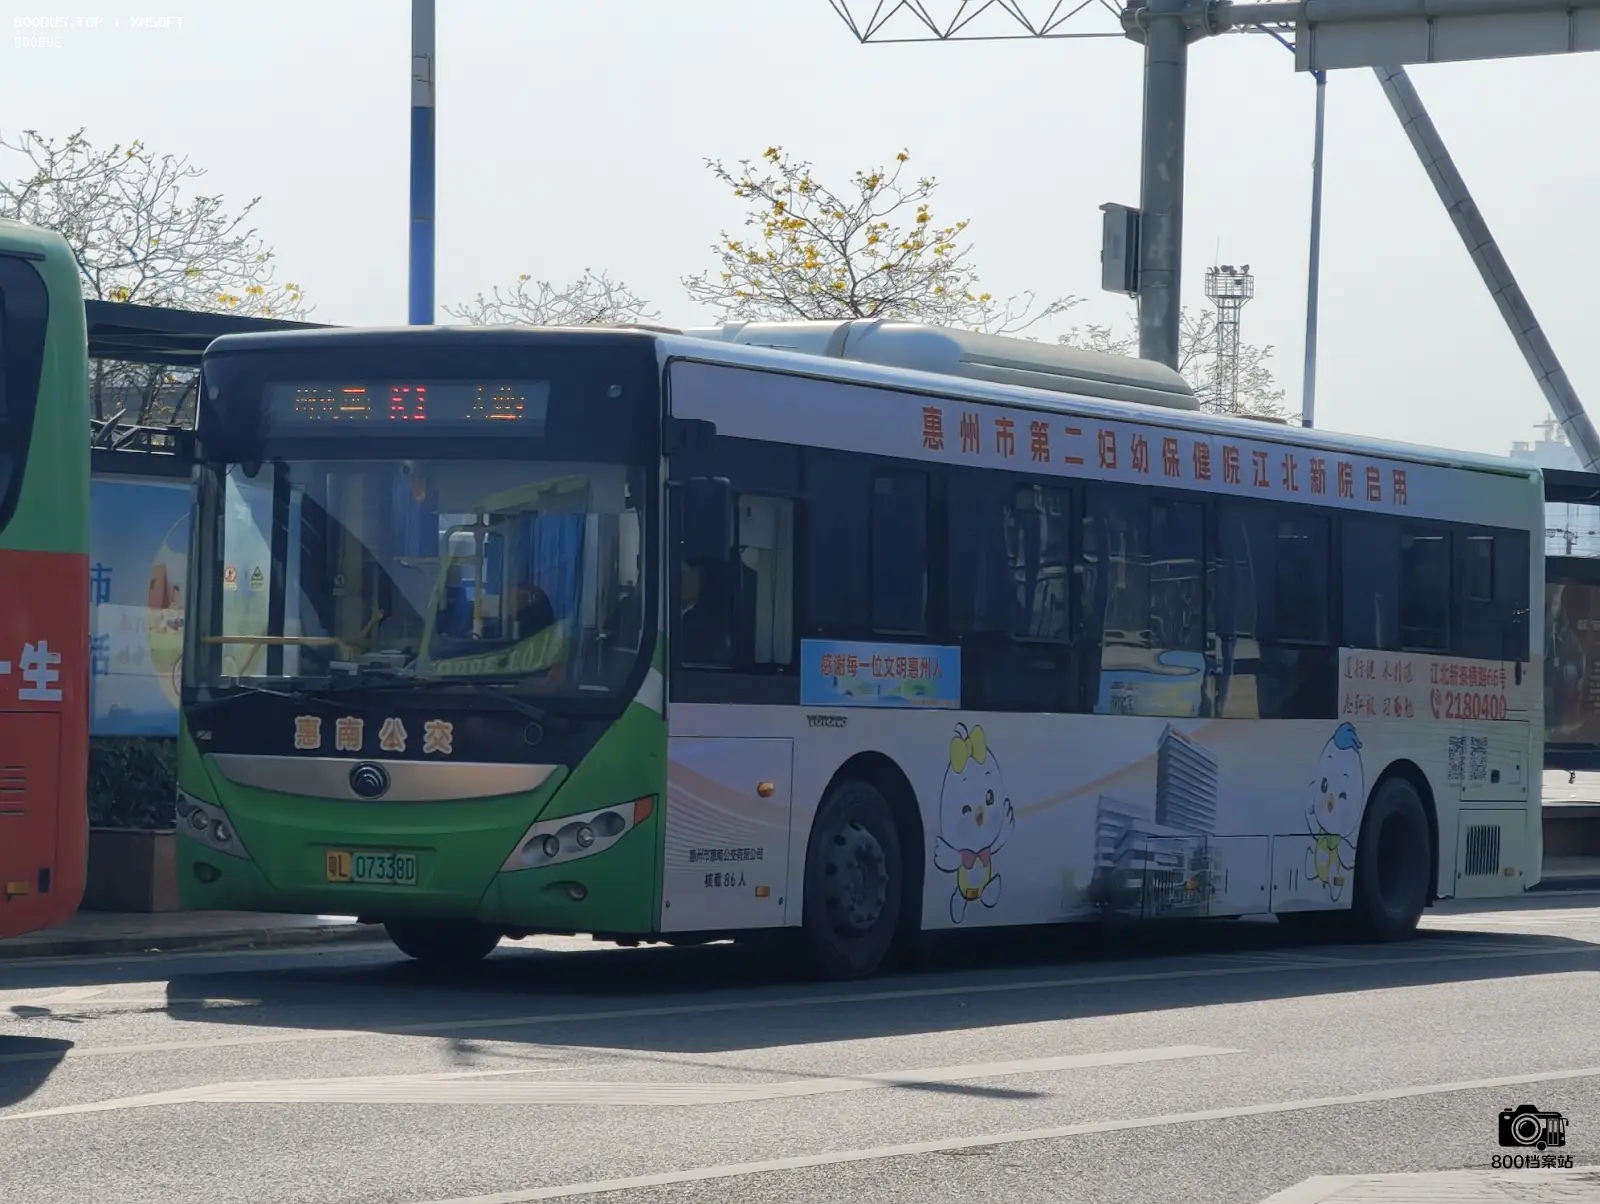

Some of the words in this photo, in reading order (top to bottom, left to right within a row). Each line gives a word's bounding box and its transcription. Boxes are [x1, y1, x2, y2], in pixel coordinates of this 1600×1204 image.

[922, 405, 1408, 506] 惠州市第二妇幼保健院江北新院启用
[0, 640, 63, 702] 生
[820, 653, 943, 680] 感谢每一位文明惠州人
[1445, 690, 1508, 720] 2180400
[294, 715, 453, 754] 惠南公交
